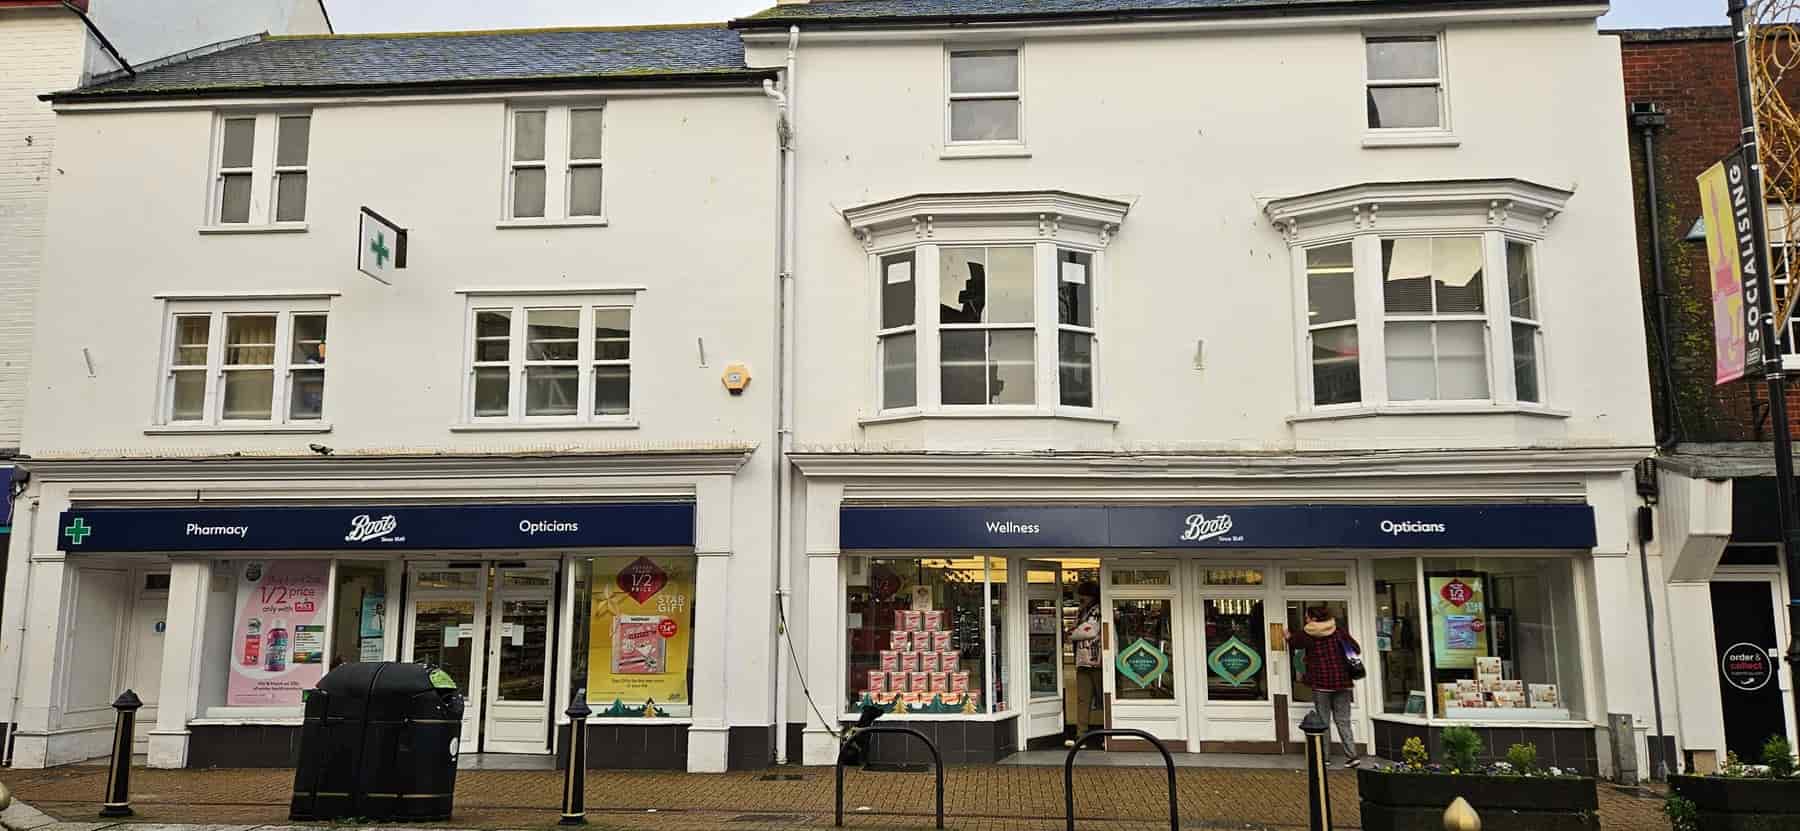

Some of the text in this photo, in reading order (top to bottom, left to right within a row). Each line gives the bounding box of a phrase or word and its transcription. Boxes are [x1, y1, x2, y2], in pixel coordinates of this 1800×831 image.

[1729, 164, 1760, 344] SOCIALISING
[186, 523, 248, 538] Pharmacy
[345, 514, 397, 542] Boots
[519, 520, 579, 535] Opticians
[984, 521, 1041, 533] Wellness
[1181, 514, 1233, 541] Boots
[1380, 520, 1446, 536] Opticians
[632, 574, 653, 587] 1/2
[259, 585, 316, 605] 1/2 price
[657, 594, 685, 604] STAR
[657, 604, 685, 613] GIFT
